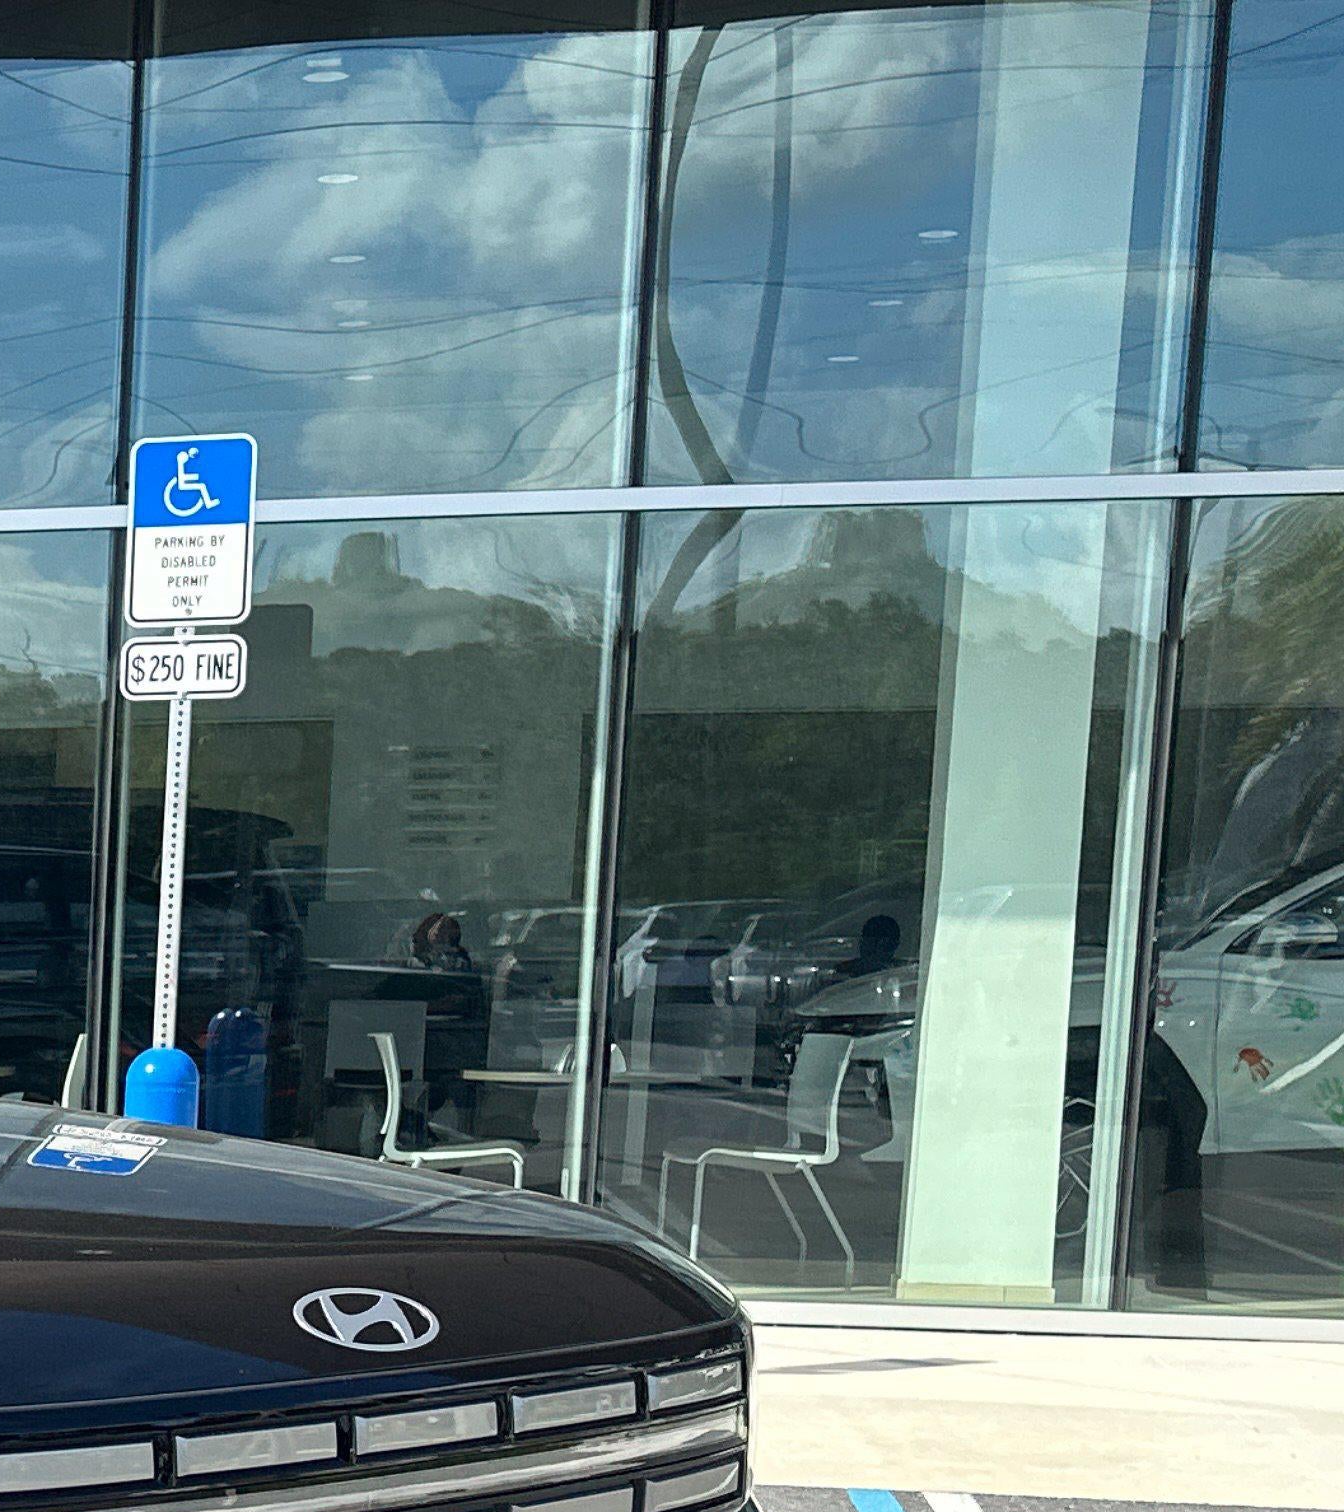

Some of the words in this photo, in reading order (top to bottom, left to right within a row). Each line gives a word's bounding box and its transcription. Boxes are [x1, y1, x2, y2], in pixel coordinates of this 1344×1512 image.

[155, 535, 204, 549] PARKING
[210, 534, 226, 547] BY
[161, 555, 216, 569] DISABLED
[167, 575, 209, 588] PERMIT
[171, 595, 202, 608] ONLY
[130, 653, 184, 687] $250
[195, 652, 235, 682] FINE
